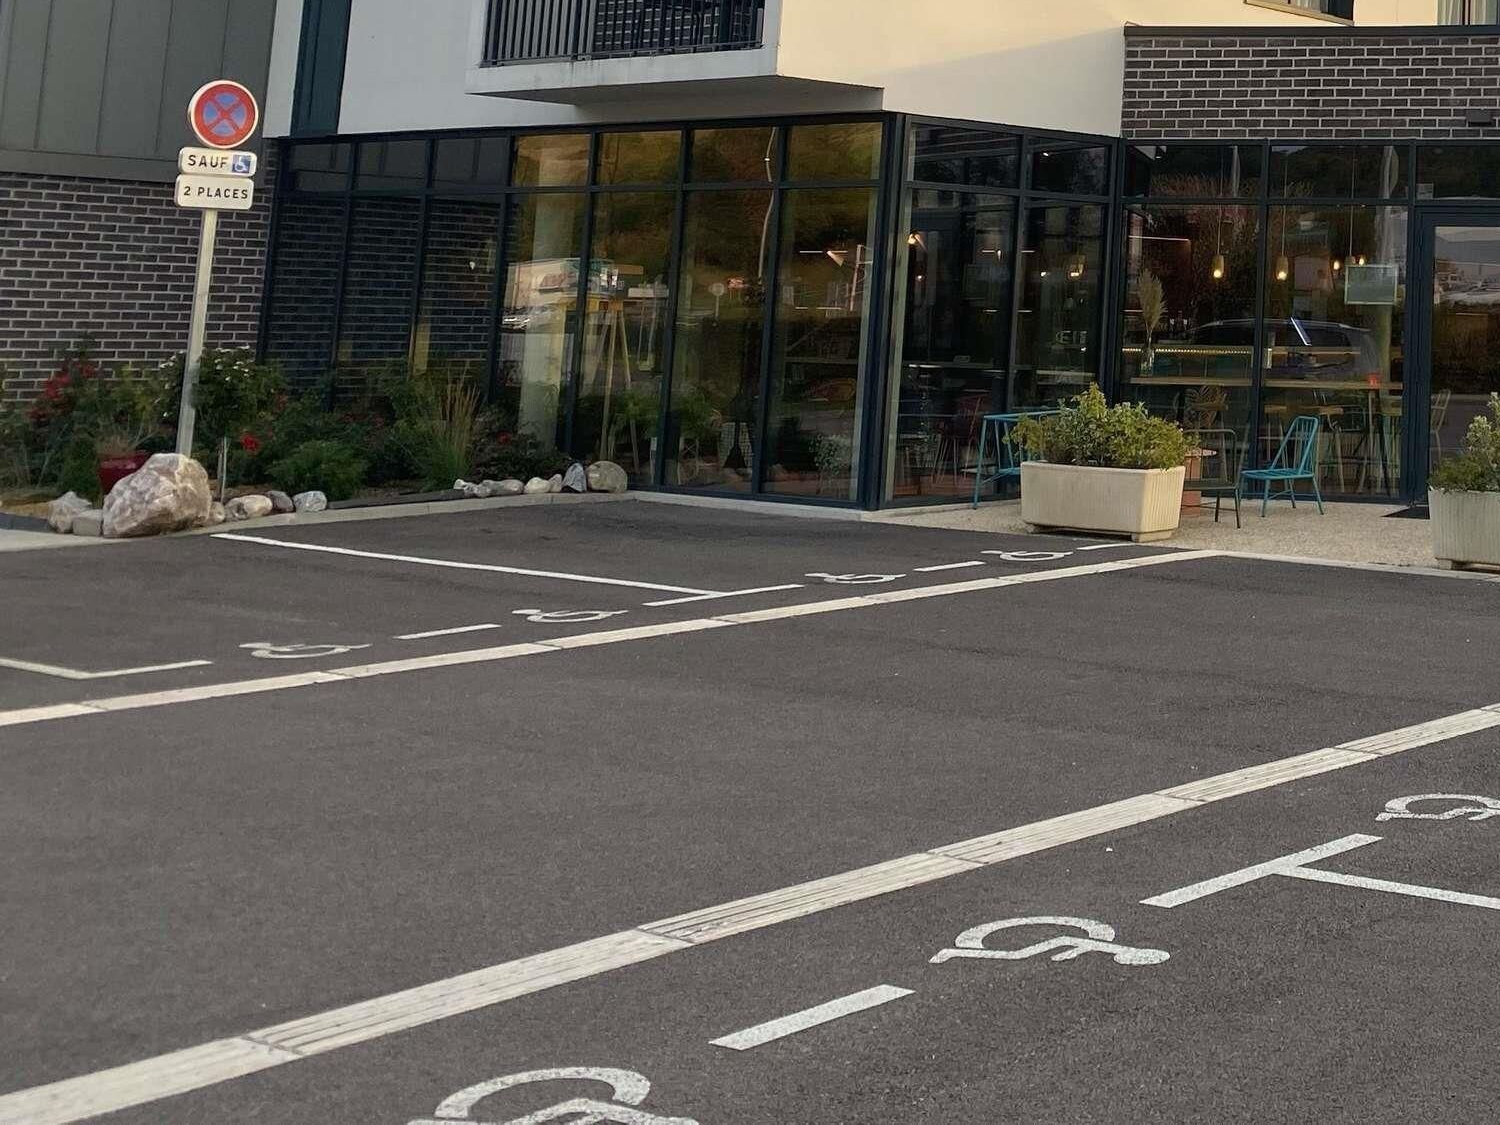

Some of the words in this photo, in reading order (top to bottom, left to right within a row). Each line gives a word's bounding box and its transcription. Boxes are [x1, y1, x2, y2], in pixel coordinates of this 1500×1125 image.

[187, 154, 228, 169] SAUF
[183, 186, 191, 196] 2
[197, 187, 248, 200] PLACES
